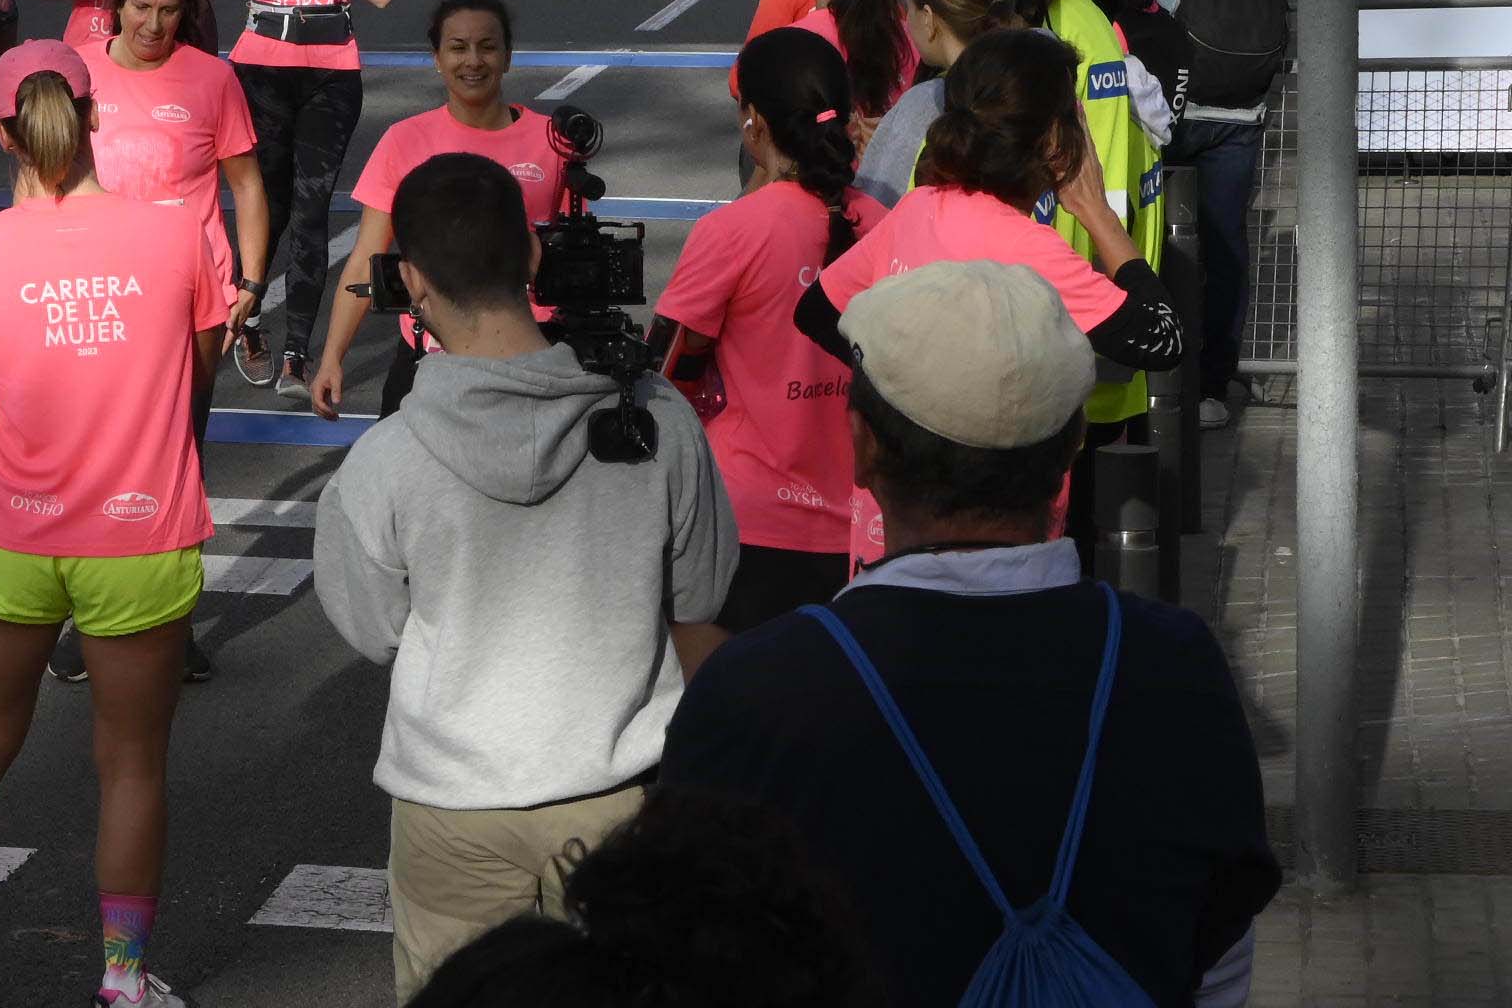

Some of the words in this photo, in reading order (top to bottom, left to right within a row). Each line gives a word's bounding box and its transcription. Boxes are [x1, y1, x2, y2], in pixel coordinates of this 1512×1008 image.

[20, 276, 143, 304] CARRERA
[47, 300, 78, 324] DE
[88, 300, 120, 320] LA
[45, 322, 127, 347] MUJER
[77, 347, 98, 357] 2023
[10, 496, 64, 516] OYSHO
[107, 503, 155, 515] ASTURIANA
[777, 487, 830, 508] OYSH
